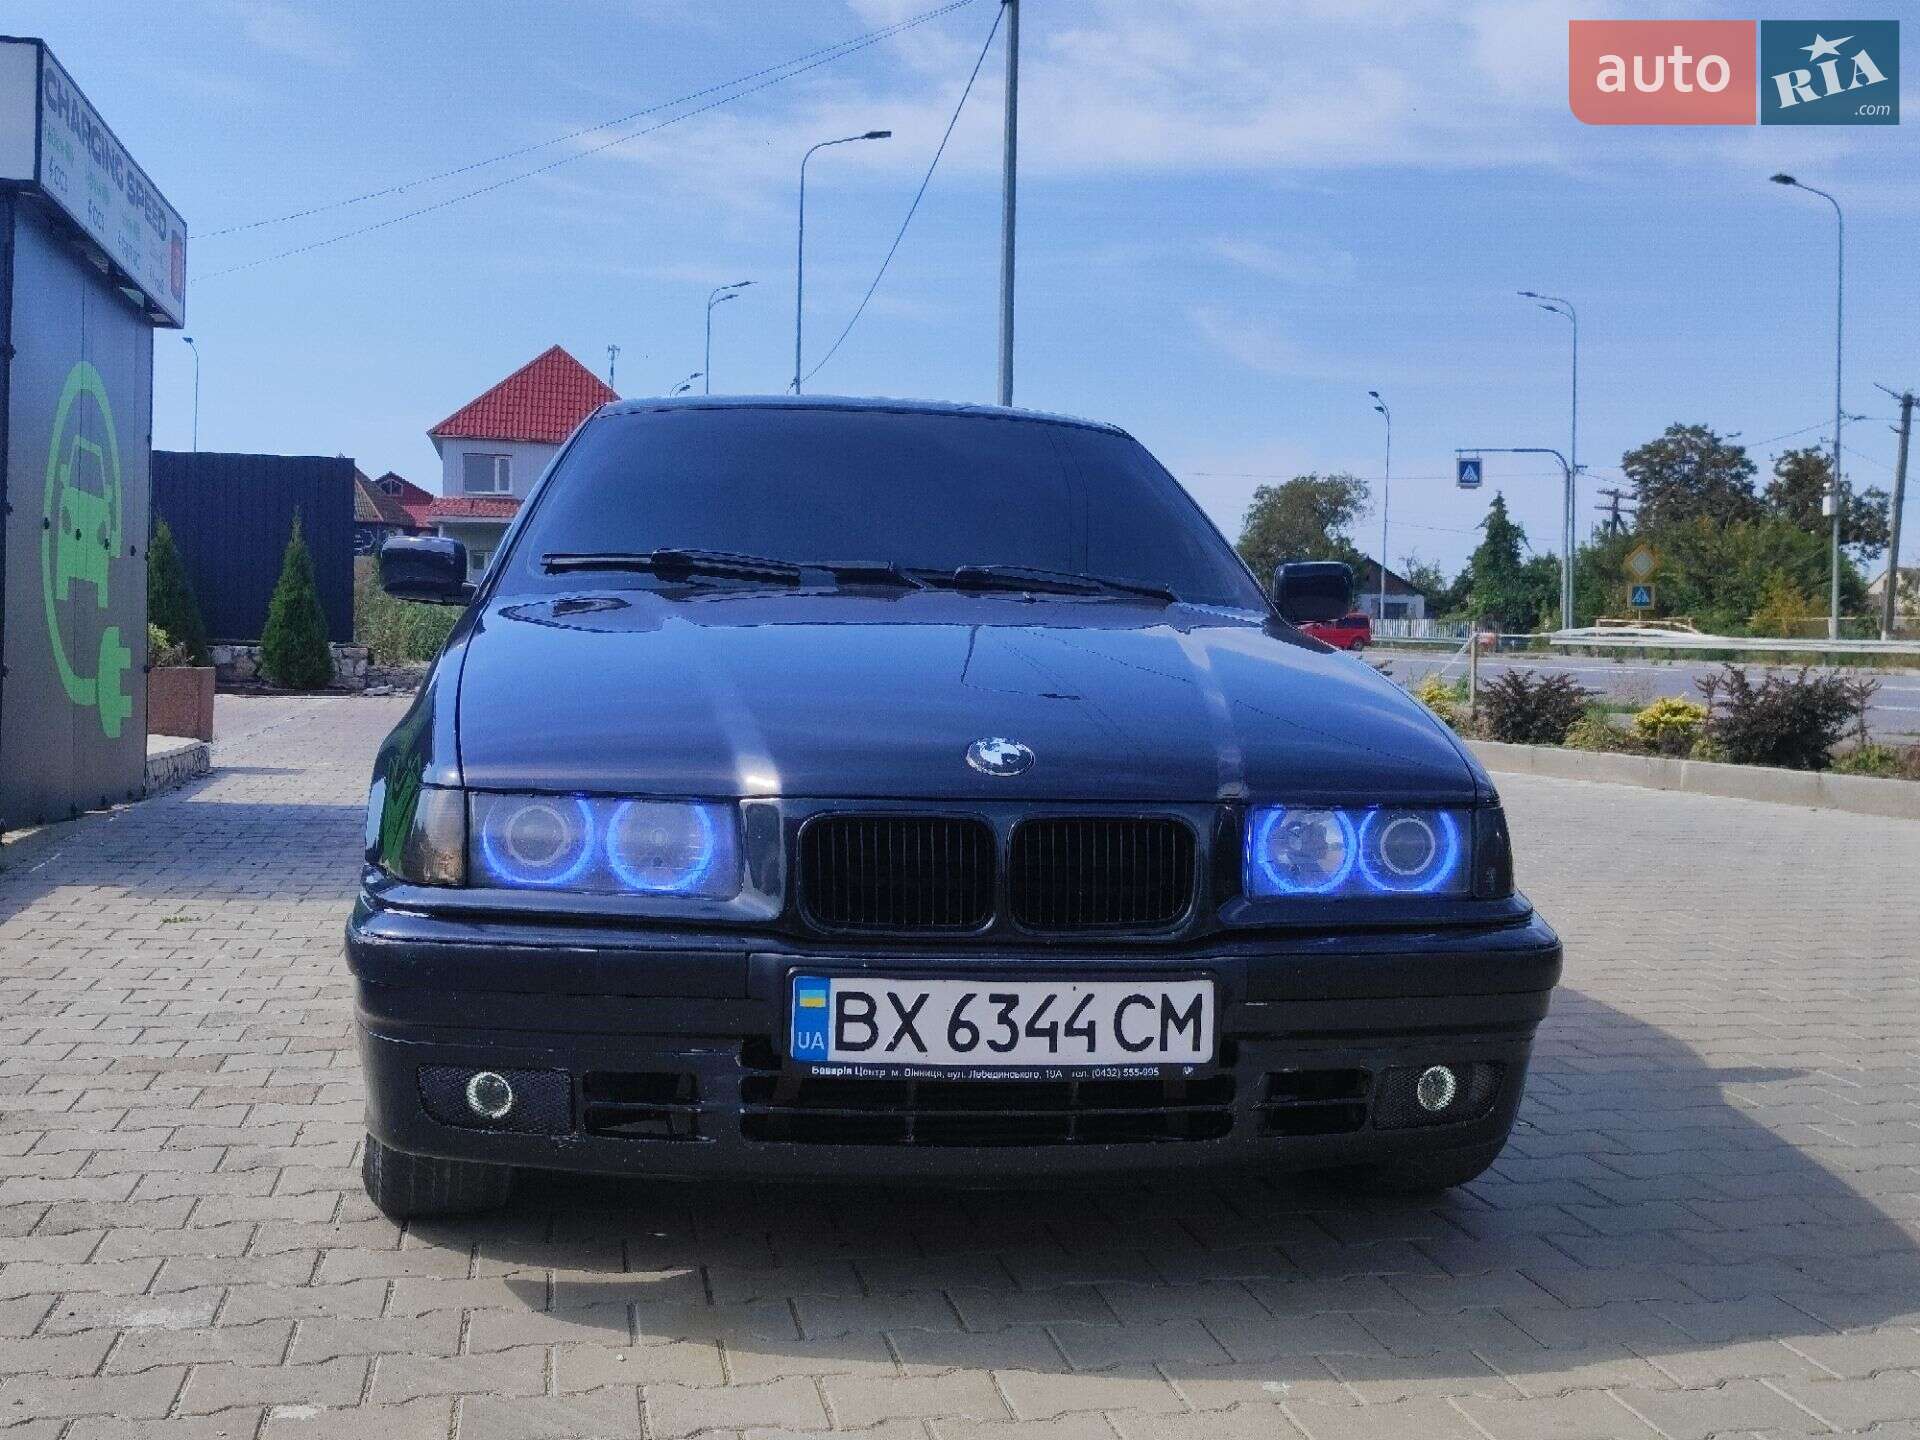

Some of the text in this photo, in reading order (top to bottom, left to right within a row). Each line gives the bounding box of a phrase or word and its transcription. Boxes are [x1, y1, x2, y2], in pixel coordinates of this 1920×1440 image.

[44, 66, 124, 192] CHARGING
[798, 1031, 825, 1050] UA
[834, 991, 1203, 1053] BX 6344 CM
